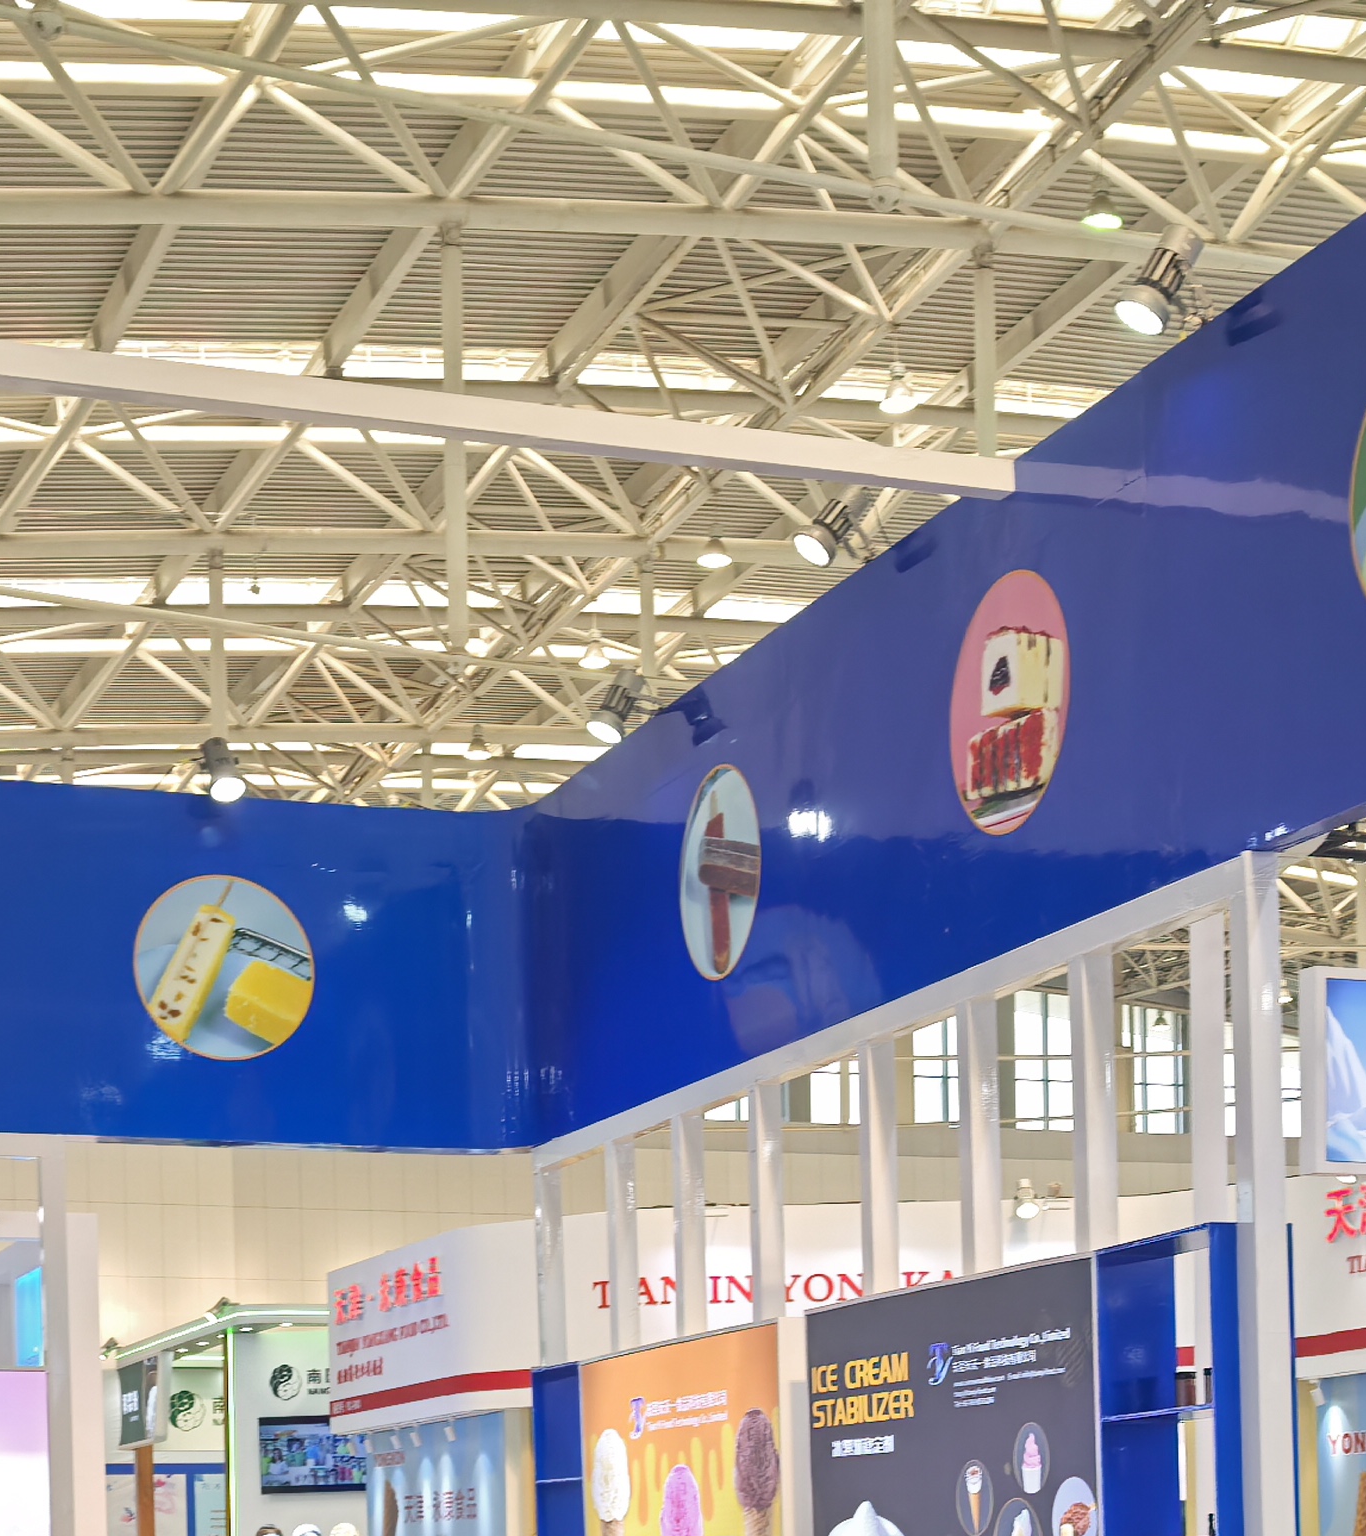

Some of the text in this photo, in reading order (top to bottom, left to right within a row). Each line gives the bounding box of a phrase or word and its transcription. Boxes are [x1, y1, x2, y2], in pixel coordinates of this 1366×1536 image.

[811, 1352, 909, 1394] ICE CREAM
[812, 1389, 914, 1428] STABILIZER
